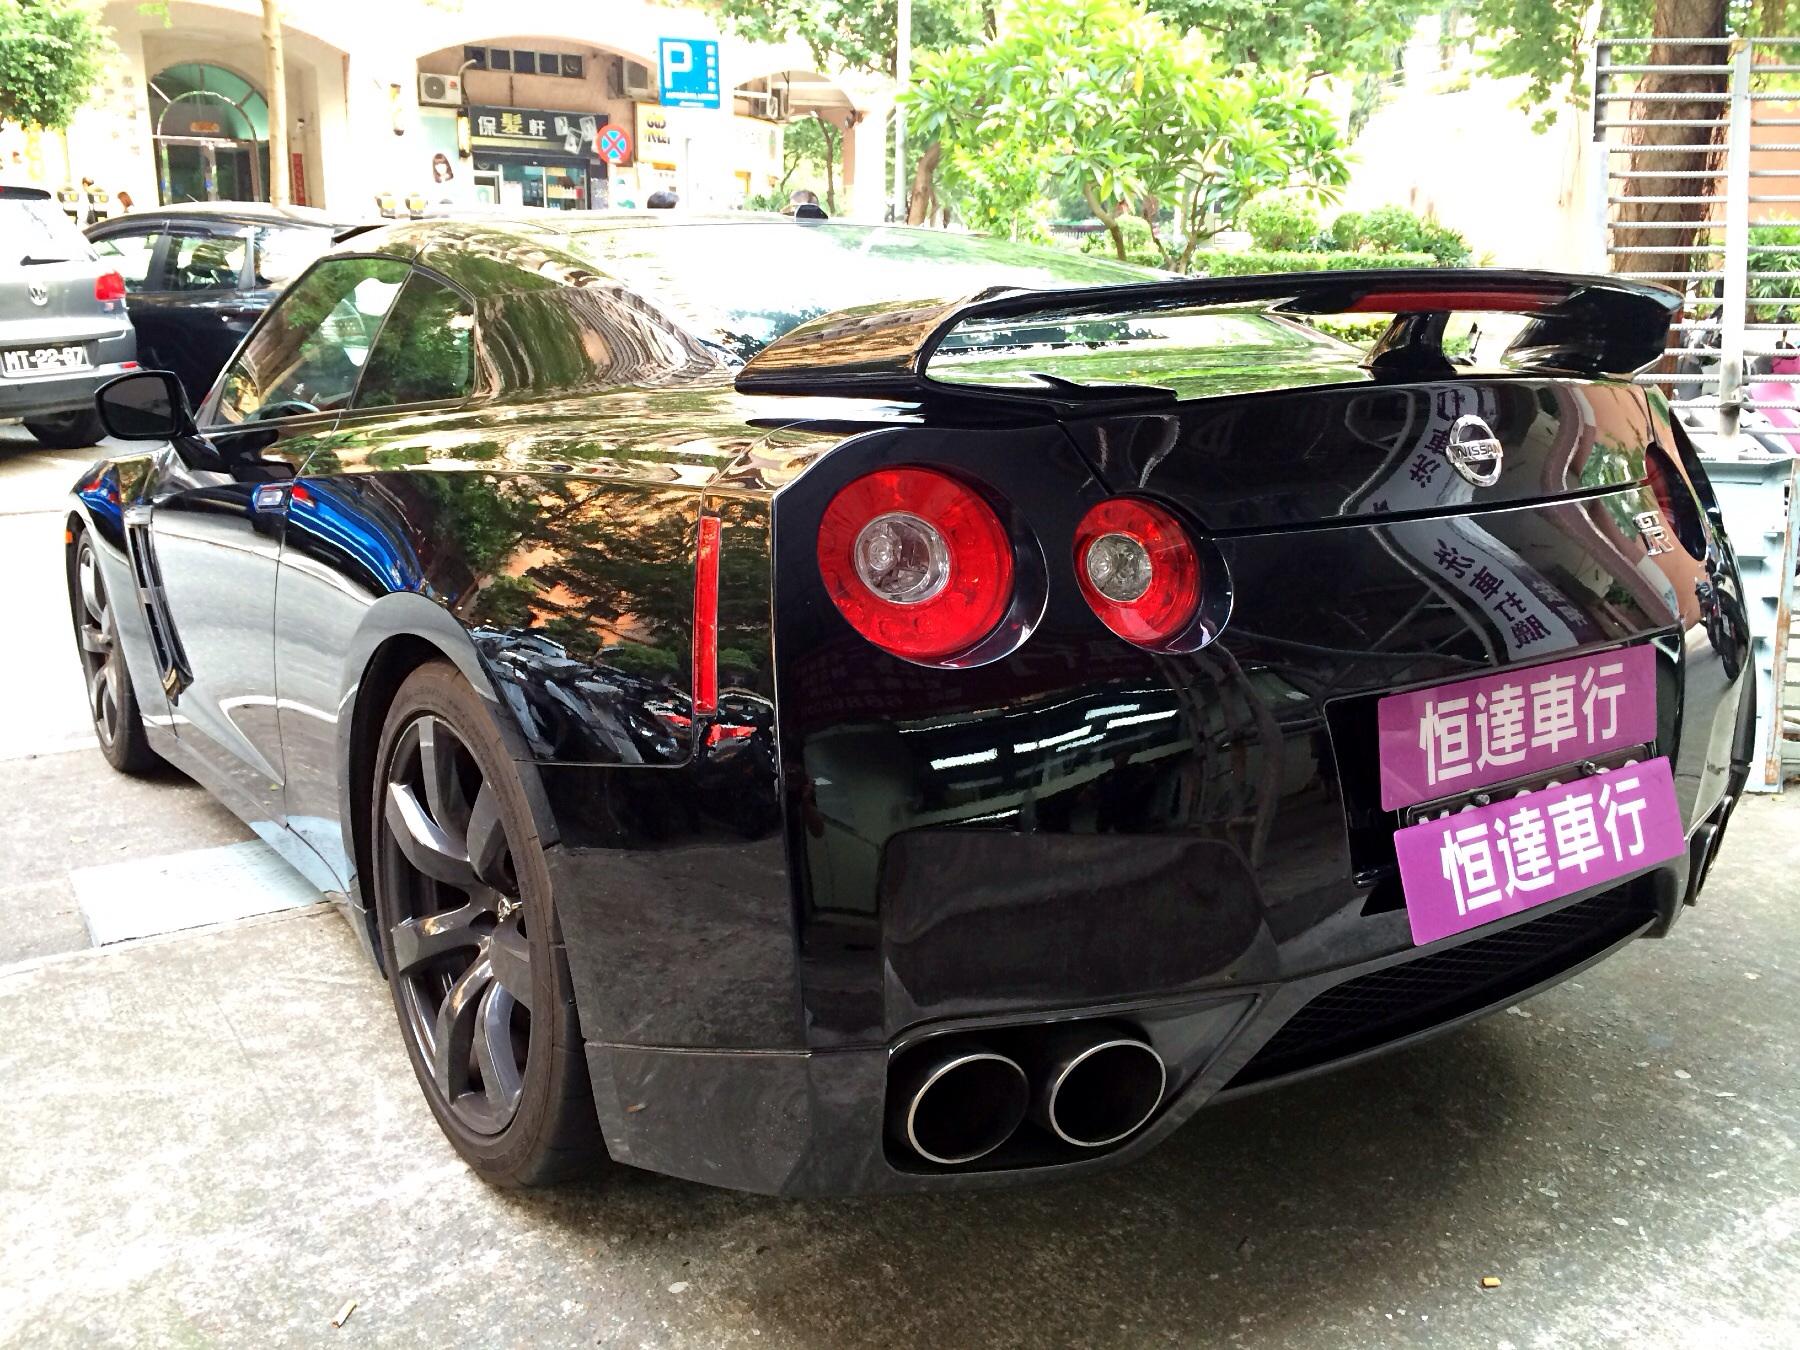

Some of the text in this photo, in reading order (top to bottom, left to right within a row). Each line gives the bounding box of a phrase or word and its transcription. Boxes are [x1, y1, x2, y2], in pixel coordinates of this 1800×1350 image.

[662, 42, 693, 89] P
[478, 113, 546, 136] 保髮軒
[1461, 442, 1501, 458] NISSAN
[1419, 662, 1626, 785] 恒達車行
[1440, 777, 1647, 916] 恒達車行
